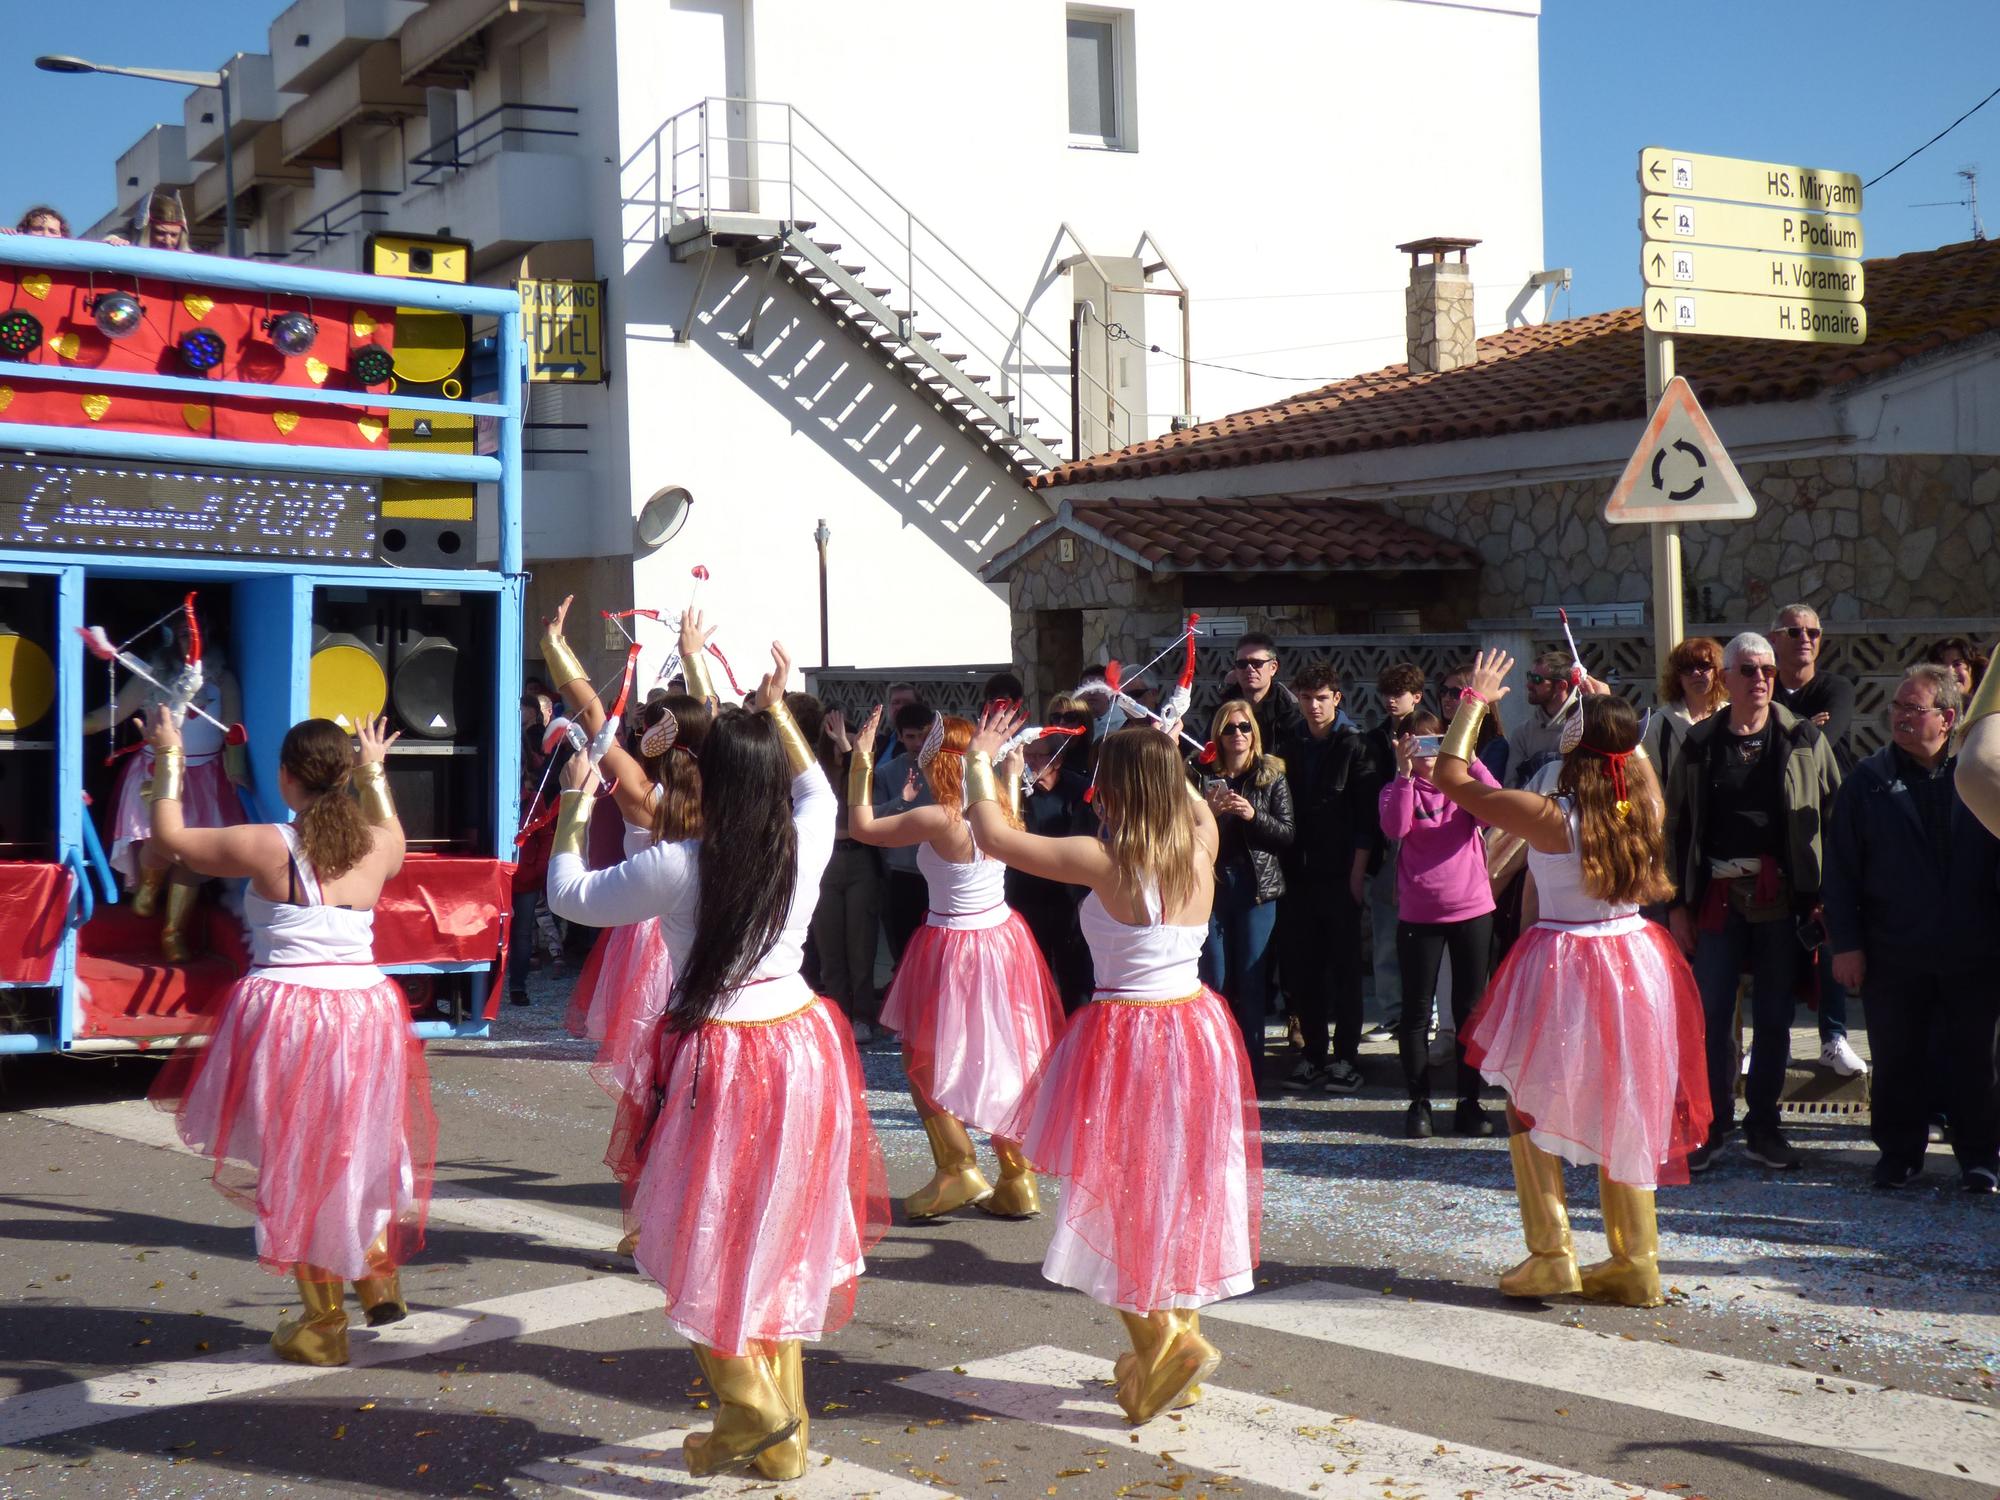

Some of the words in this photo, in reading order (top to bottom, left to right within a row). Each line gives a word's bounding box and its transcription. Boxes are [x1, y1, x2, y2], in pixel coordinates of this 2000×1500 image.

[1767, 171, 1794, 198] HS.
[1799, 175, 1856, 207] Miryam
[1783, 217, 1795, 242] P.
[1800, 219, 1857, 249] Podium
[1772, 261, 1788, 286] H.
[1792, 263, 1857, 291] Voramar
[521, 283, 595, 308] PARKING
[522, 311, 597, 356] HOTEL
[1779, 305, 1796, 330] H.
[1800, 307, 1859, 335] Bonaire
[1063, 542, 1070, 558] 2
